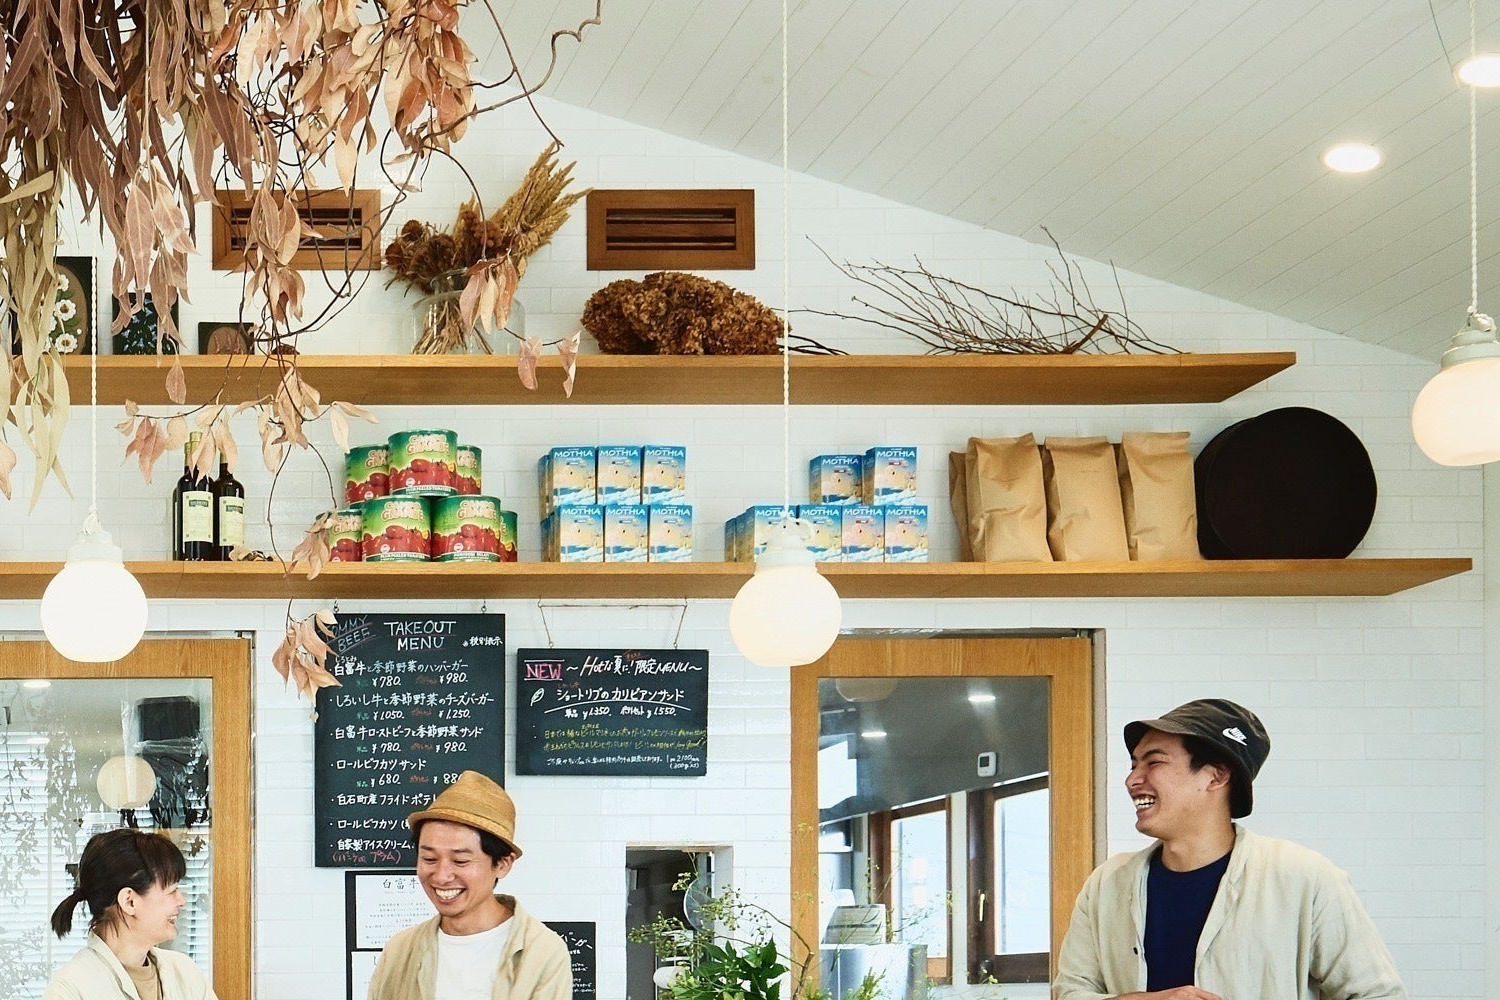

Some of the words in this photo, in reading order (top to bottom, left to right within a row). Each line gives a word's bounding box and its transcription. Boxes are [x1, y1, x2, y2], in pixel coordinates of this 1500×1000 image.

[554, 450, 594, 458] MOTHIA
[645, 450, 684, 458] MOTHIA
[877, 450, 915, 458] MOTHIA
[822, 458, 859, 466] MOTHIA
[562, 508, 601, 516] MOTHIA
[607, 508, 646, 516] MOTHIA
[651, 508, 690, 516] MOTHIA
[756, 509, 795, 517] MOTA
[801, 508, 840, 516] MOTHIA
[844, 508, 883, 516] MOTHIA
[887, 508, 926, 516] MOTHIA
[384, 620, 456, 636] TAKEOUT
[338, 628, 370, 652] BEEF
[397, 636, 445, 650] MENU
[526, 663, 562, 680] NEW
